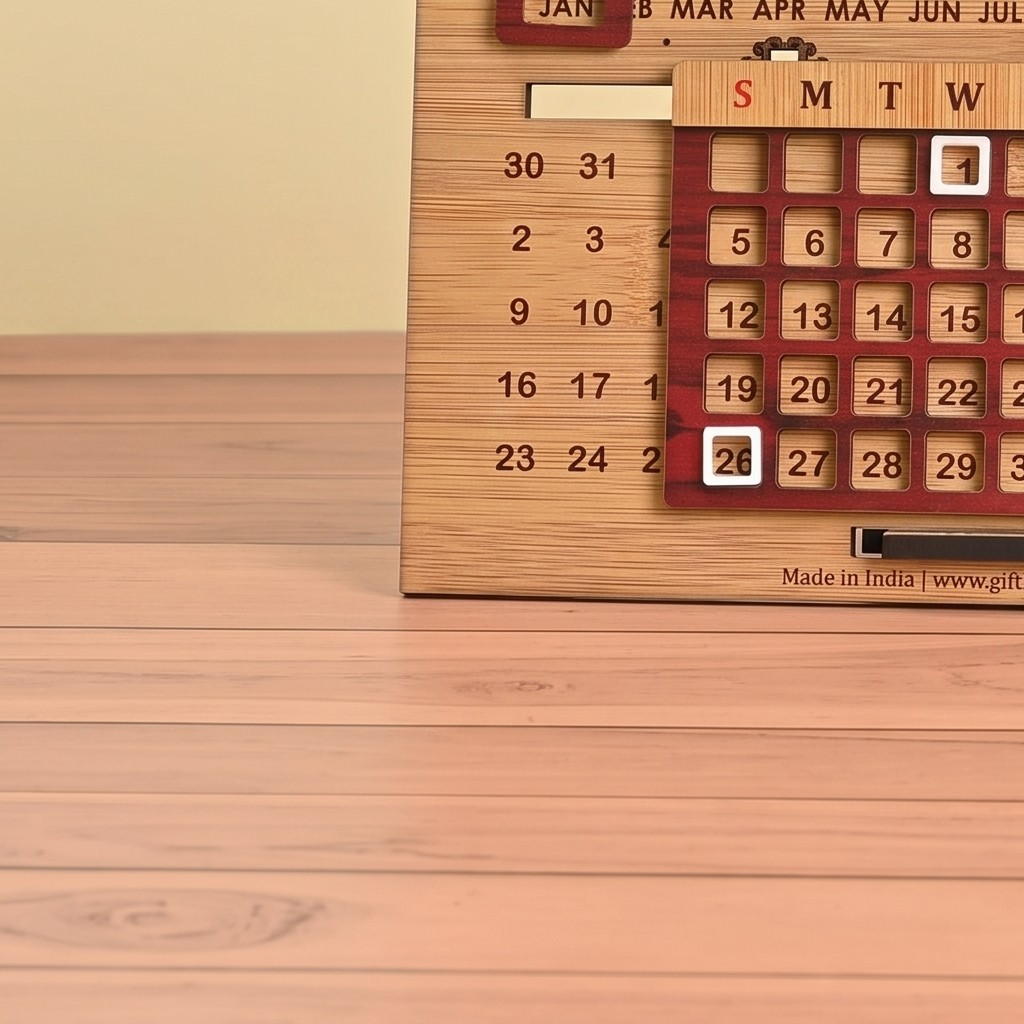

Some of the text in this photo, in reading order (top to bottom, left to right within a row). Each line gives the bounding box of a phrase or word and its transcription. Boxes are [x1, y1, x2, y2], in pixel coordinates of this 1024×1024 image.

[825, 0, 889, 22] MAY
[908, 0, 961, 23] JUN
[978, 1, 1023, 24] JUL
[733, 79, 752, 108] S
[800, 80, 833, 110] M
[878, 81, 903, 110] T
[945, 82, 985, 112] W
[503, 151, 544, 179] 30
[579, 152, 615, 180] 31
[957, 158, 973, 184] 1
[512, 225, 531, 252] 2
[585, 226, 604, 253] 3
[732, 228, 751, 255] 5
[805, 229, 825, 256] 6
[879, 231, 898, 257] 7
[953, 231, 972, 258] 8
[510, 298, 529, 326] 9
[573, 298, 612, 326] 10
[719, 302, 759, 329] 12
[793, 302, 833, 330] 13
[867, 304, 907, 331] 14
[941, 306, 980, 332] 15
[497, 371, 537, 399] 16
[570, 372, 611, 400] 17
[717, 375, 757, 402] 19
[790, 375, 830, 404] 20
[866, 377, 904, 404] 21
[937, 379, 978, 406] 22
[495, 444, 535, 472] 23
[567, 445, 608, 473] 24
[715, 448, 751, 475] 26
[788, 449, 829, 476] 27
[862, 451, 902, 478] 28
[936, 452, 976, 480] 29
[783, 567, 835, 586] Made
[841, 568, 859, 587] in
[865, 569, 914, 588] India
